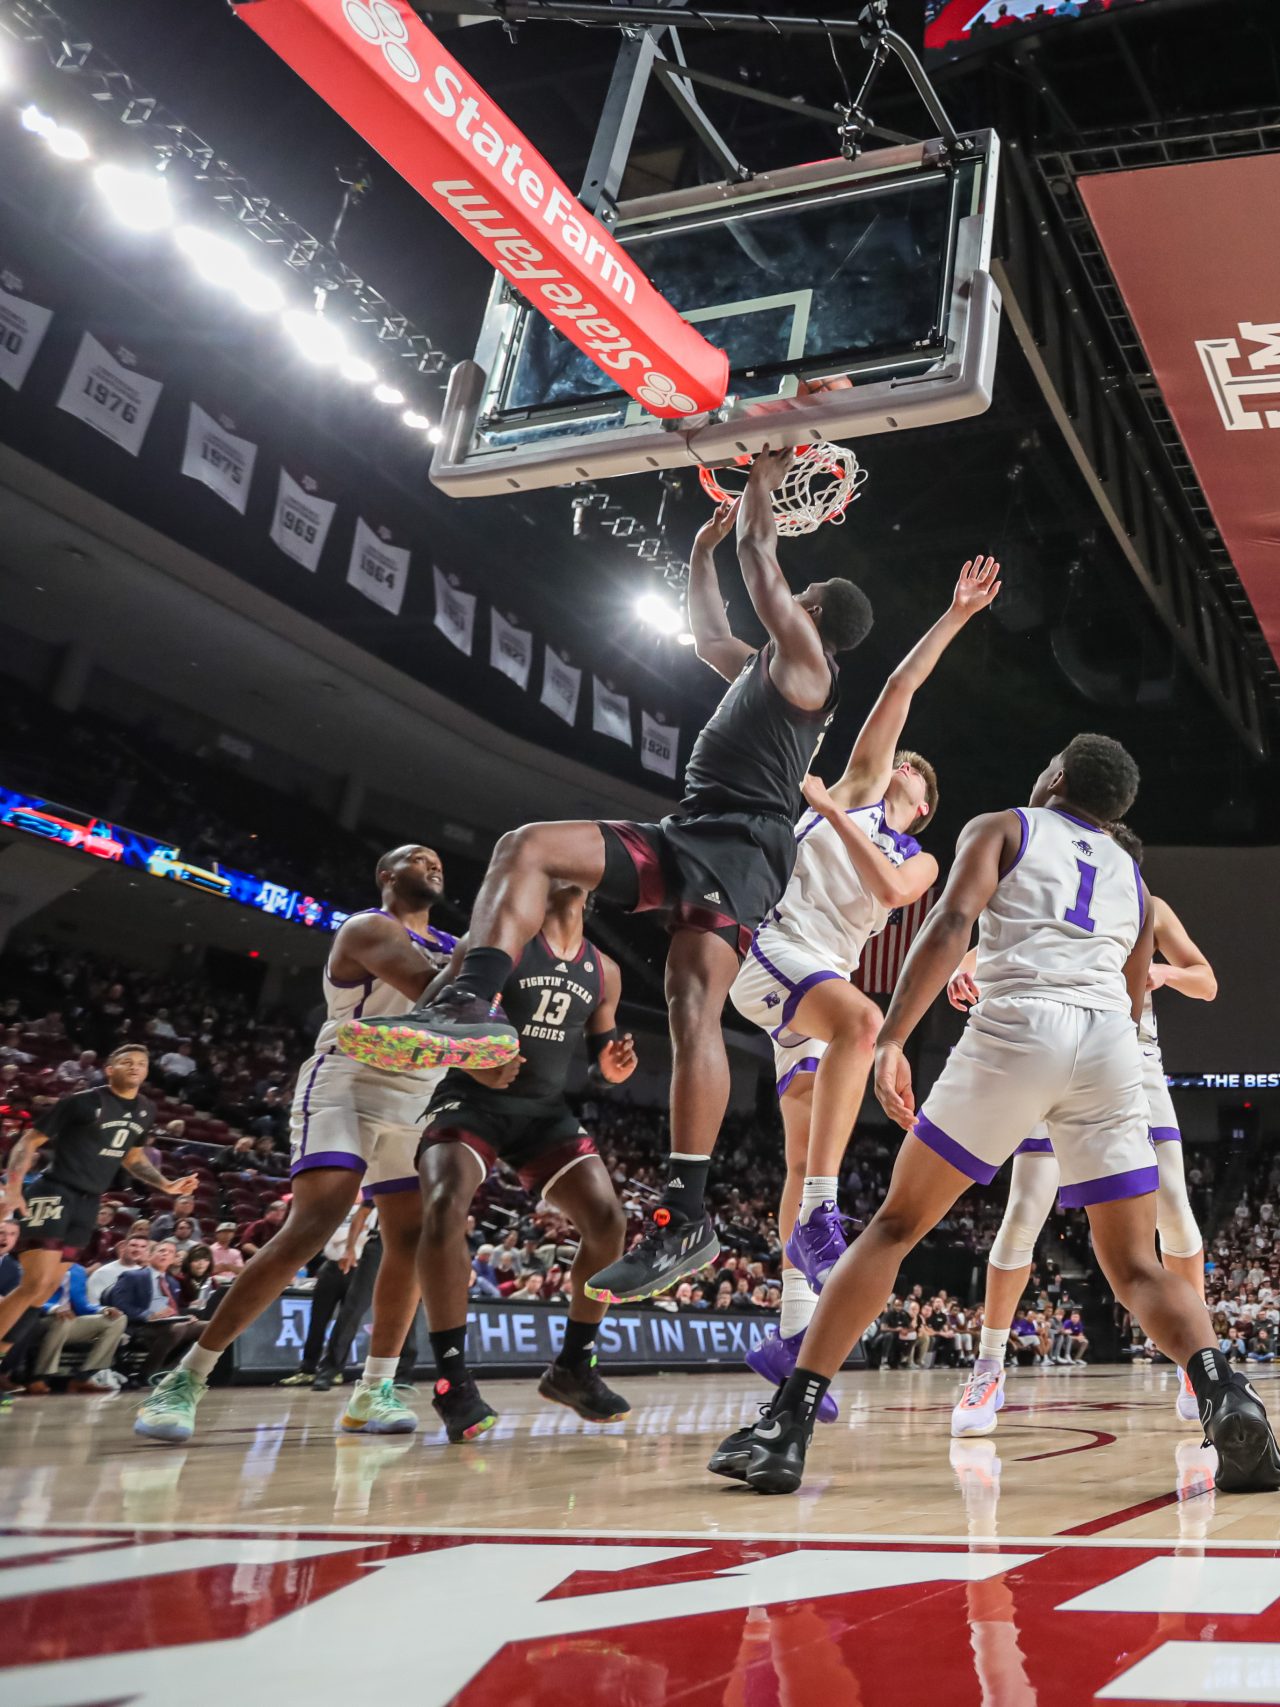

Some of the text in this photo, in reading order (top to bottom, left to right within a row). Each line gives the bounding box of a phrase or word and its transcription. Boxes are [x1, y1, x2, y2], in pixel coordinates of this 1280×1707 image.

[1064, 857, 1098, 934] 1
[519, 976, 593, 1004] FIGHTIN' TEXAS
[531, 989, 572, 1026] 13
[522, 1024, 566, 1042] AGGIES
[1203, 1074, 1240, 1088] THE
[111, 1129, 130, 1148] 0
[547, 1315, 640, 1352] BST
[650, 1318, 685, 1352] IN
